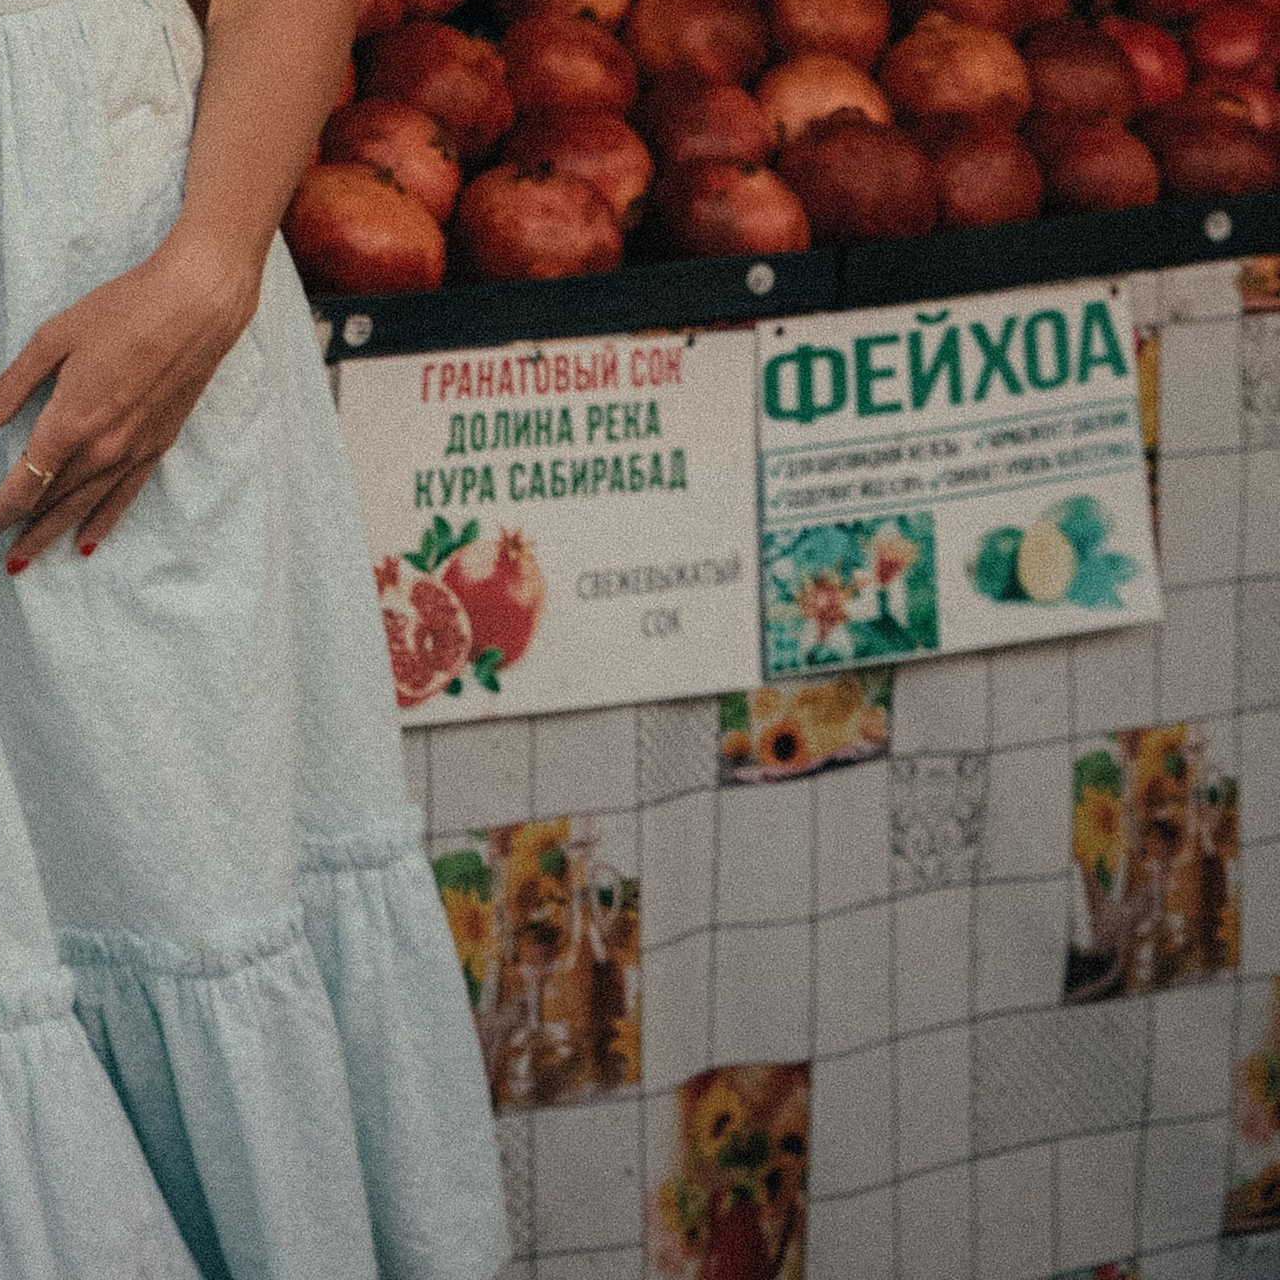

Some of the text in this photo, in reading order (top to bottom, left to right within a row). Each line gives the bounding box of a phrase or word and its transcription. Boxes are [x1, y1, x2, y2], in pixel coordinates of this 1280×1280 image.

[420, 342, 683, 403] ГРАНАТОВЫЙ СОК
[762, 300, 1129, 424] ФЕЙХОА
[444, 399, 661, 457] ДОЛИНА РЕКА
[414, 447, 687, 508] КУРА САБИРАБАД
